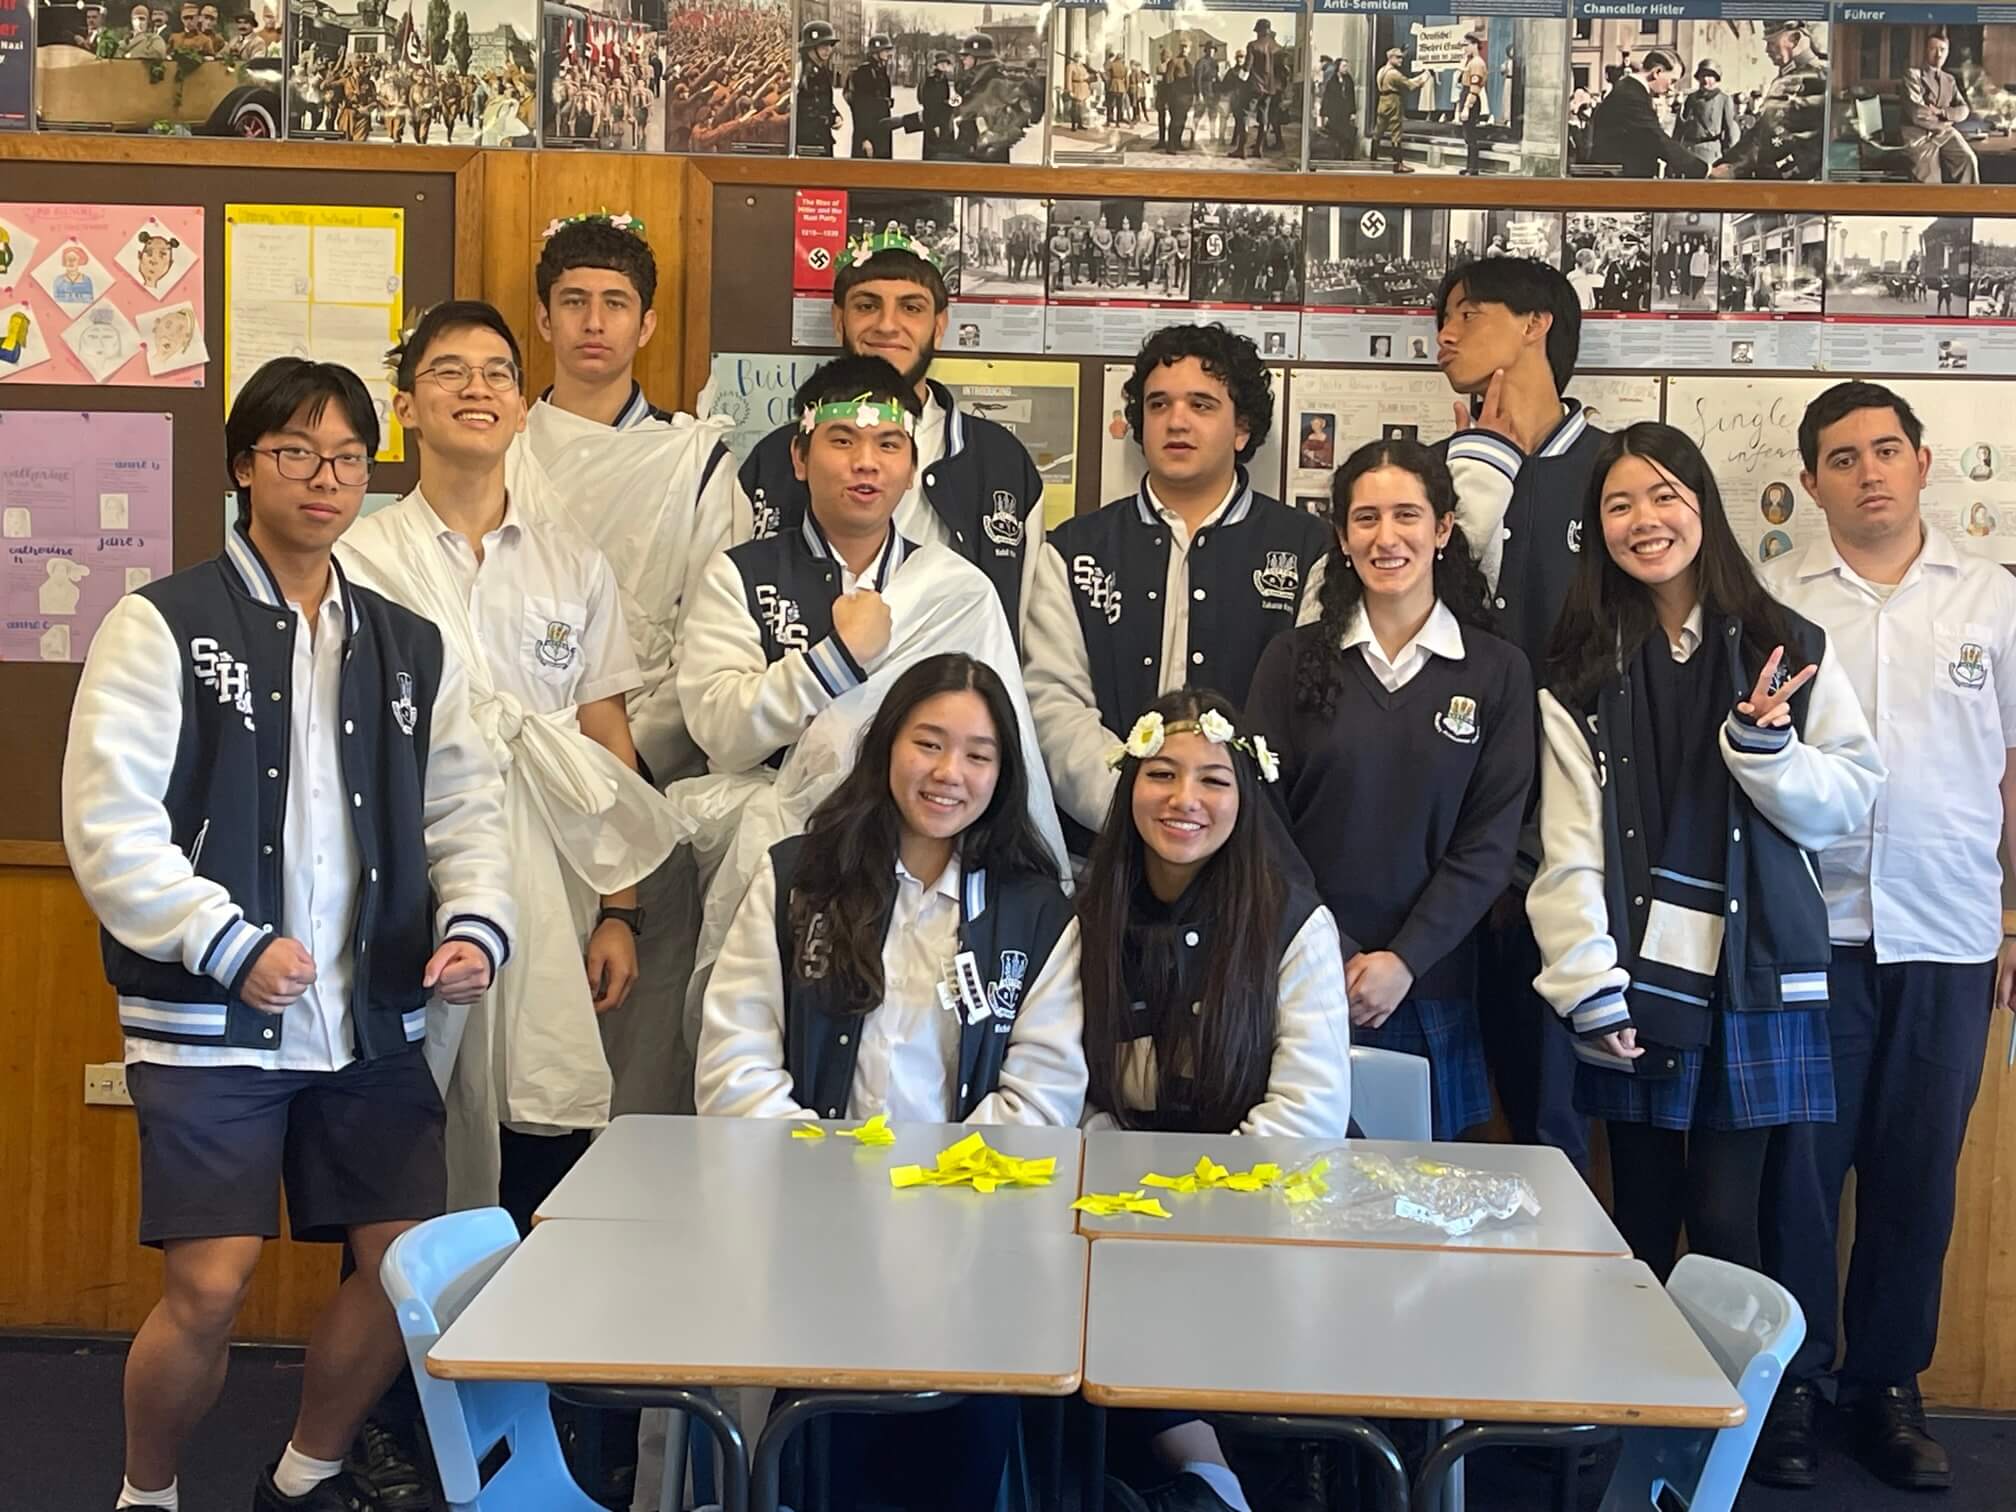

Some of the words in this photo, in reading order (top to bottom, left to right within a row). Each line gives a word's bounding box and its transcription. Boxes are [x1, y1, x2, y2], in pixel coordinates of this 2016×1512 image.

[1583, 3, 1648, 14] Chancellor
[1650, 4, 1685, 15] Hitler
[1844, 9, 1886, 20] Führer
